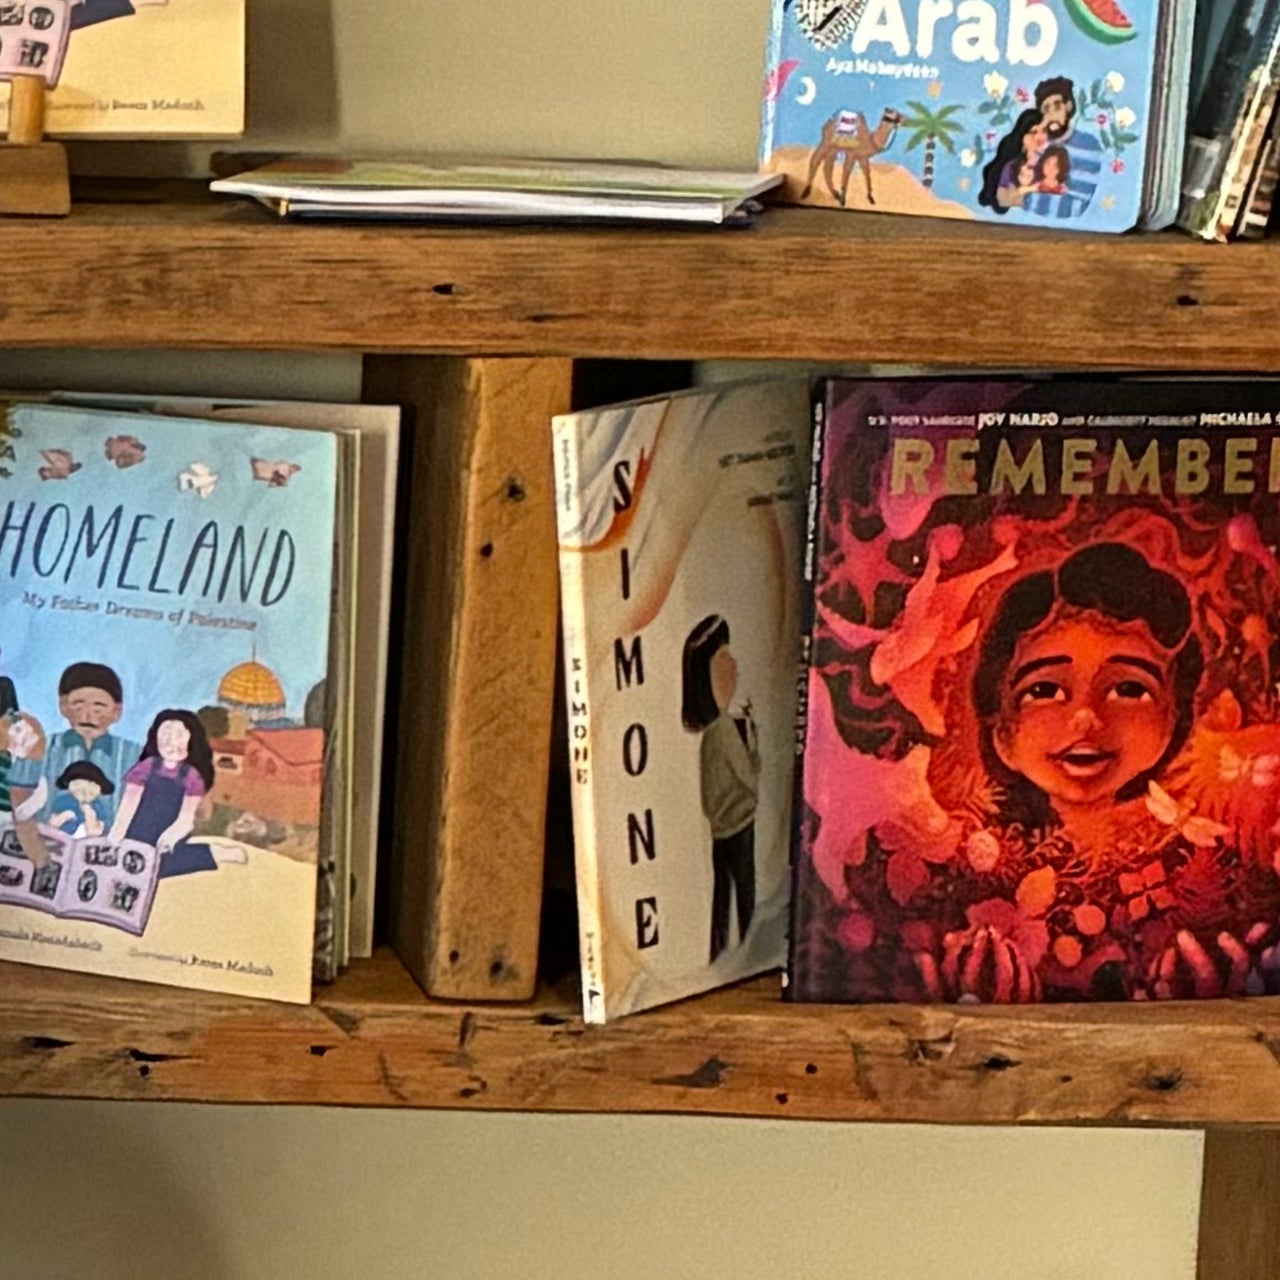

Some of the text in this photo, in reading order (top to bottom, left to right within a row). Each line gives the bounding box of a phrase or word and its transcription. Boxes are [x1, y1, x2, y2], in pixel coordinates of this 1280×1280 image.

[977, 412, 1007, 431] JOY
[887, 437, 1280, 497] REMEMBE
[23, 591, 45, 609] My
[106, 599, 164, 621] Dreams
[167, 607, 185, 627] of
[613, 458, 659, 951] SIMONE
